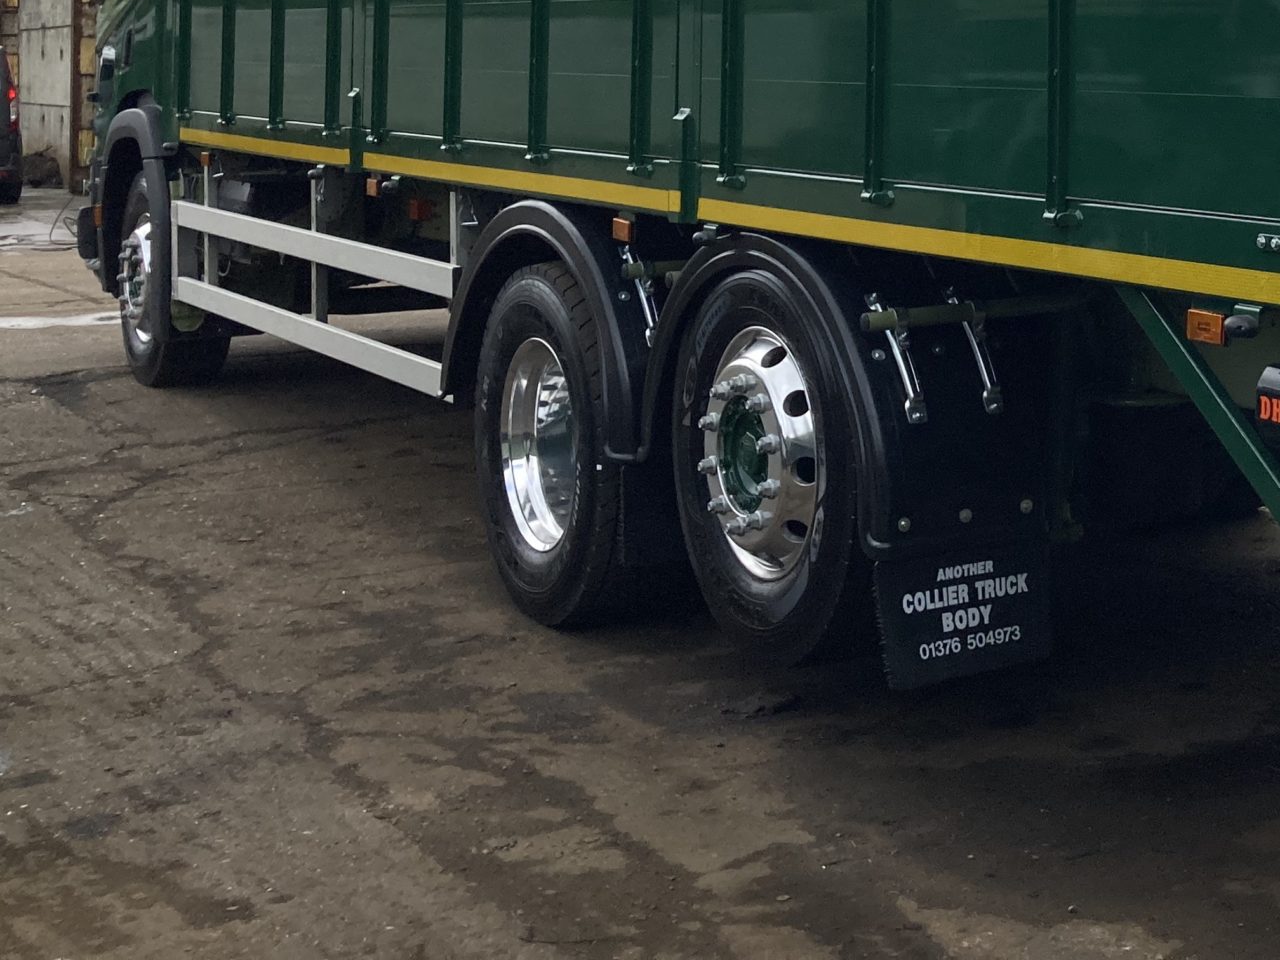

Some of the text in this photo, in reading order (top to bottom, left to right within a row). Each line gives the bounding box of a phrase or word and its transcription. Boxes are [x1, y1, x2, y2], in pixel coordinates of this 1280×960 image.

[937, 560, 994, 582] ANOTHER
[902, 572, 1029, 614] COLLIER TRUCK
[941, 604, 993, 632] BODY
[919, 625, 1021, 660] 01376 504973
